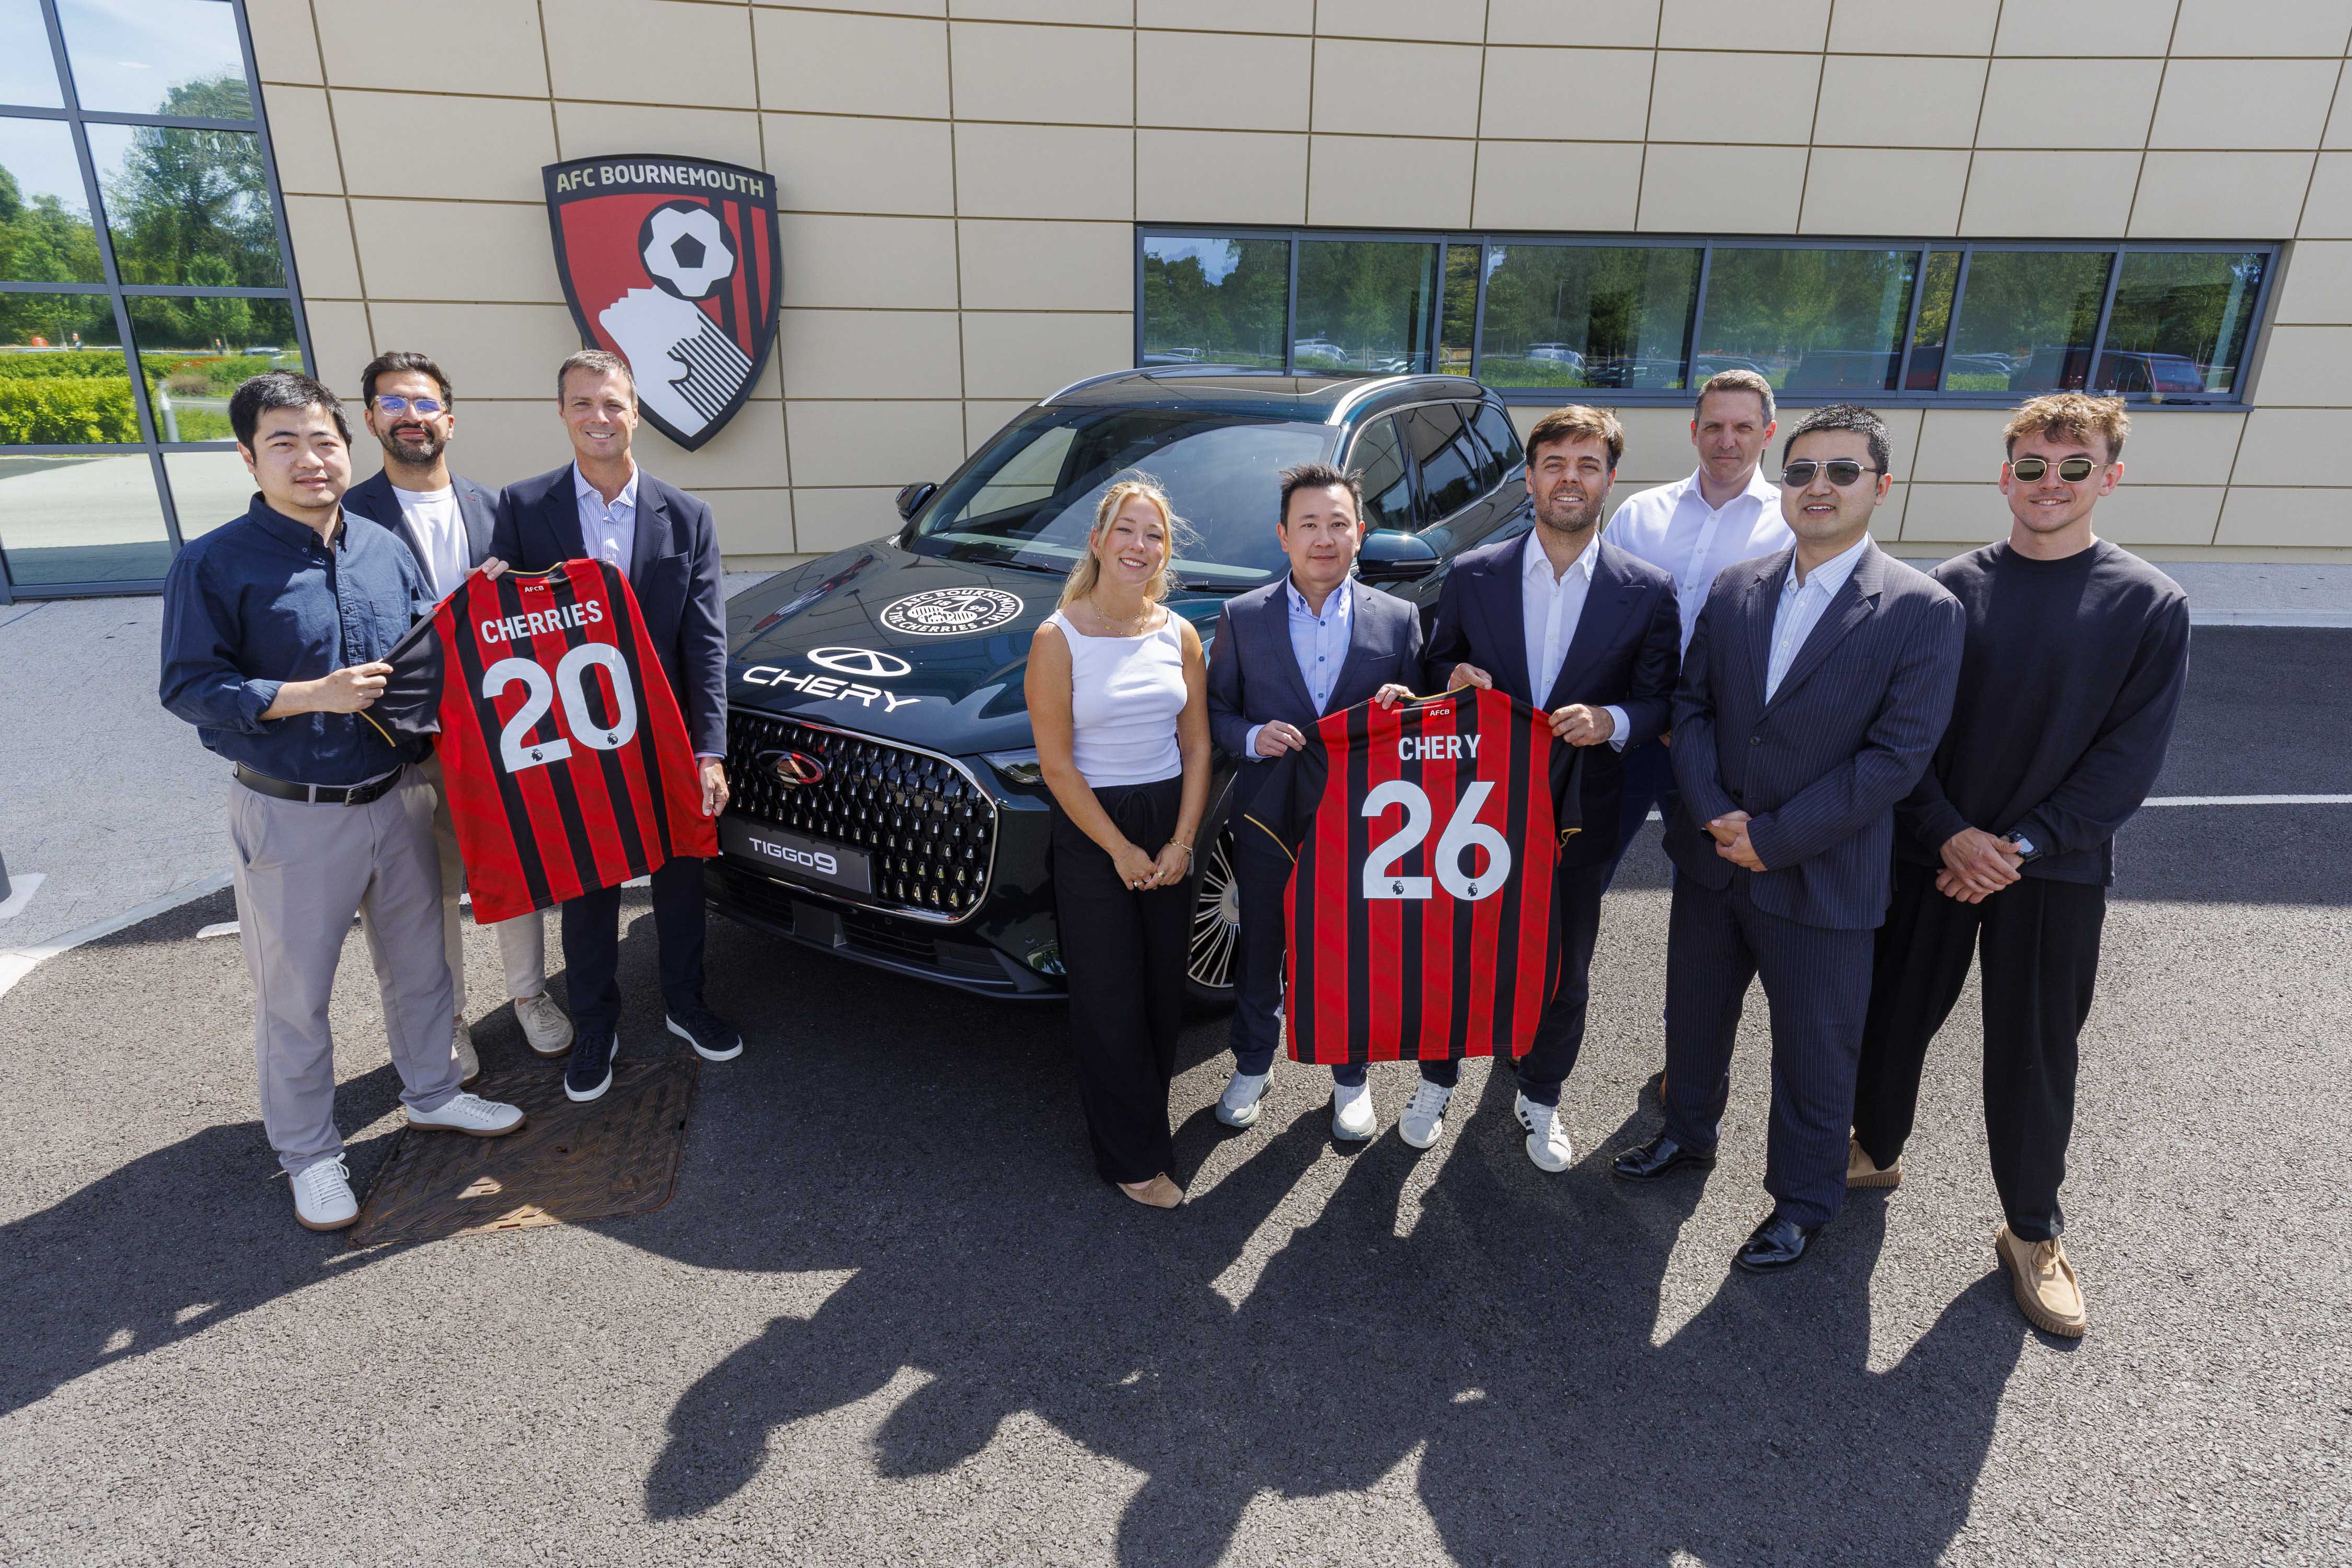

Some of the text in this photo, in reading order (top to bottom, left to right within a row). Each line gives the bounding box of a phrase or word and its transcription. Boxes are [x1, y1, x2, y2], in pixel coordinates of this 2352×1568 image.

[557, 165, 764, 198] AFC BOURNEMOUTH
[481, 600, 603, 643] CHERRIES
[889, 611, 977, 632] THE CHERRIES
[902, 590, 1016, 621] AFC BOURNEMOUTH
[482, 642, 637, 774] 20
[743, 666, 921, 712] CHERY
[1398, 735, 1481, 760] CHERY
[749, 837, 837, 875] TIGGO9
[1361, 780, 1512, 901] 26
